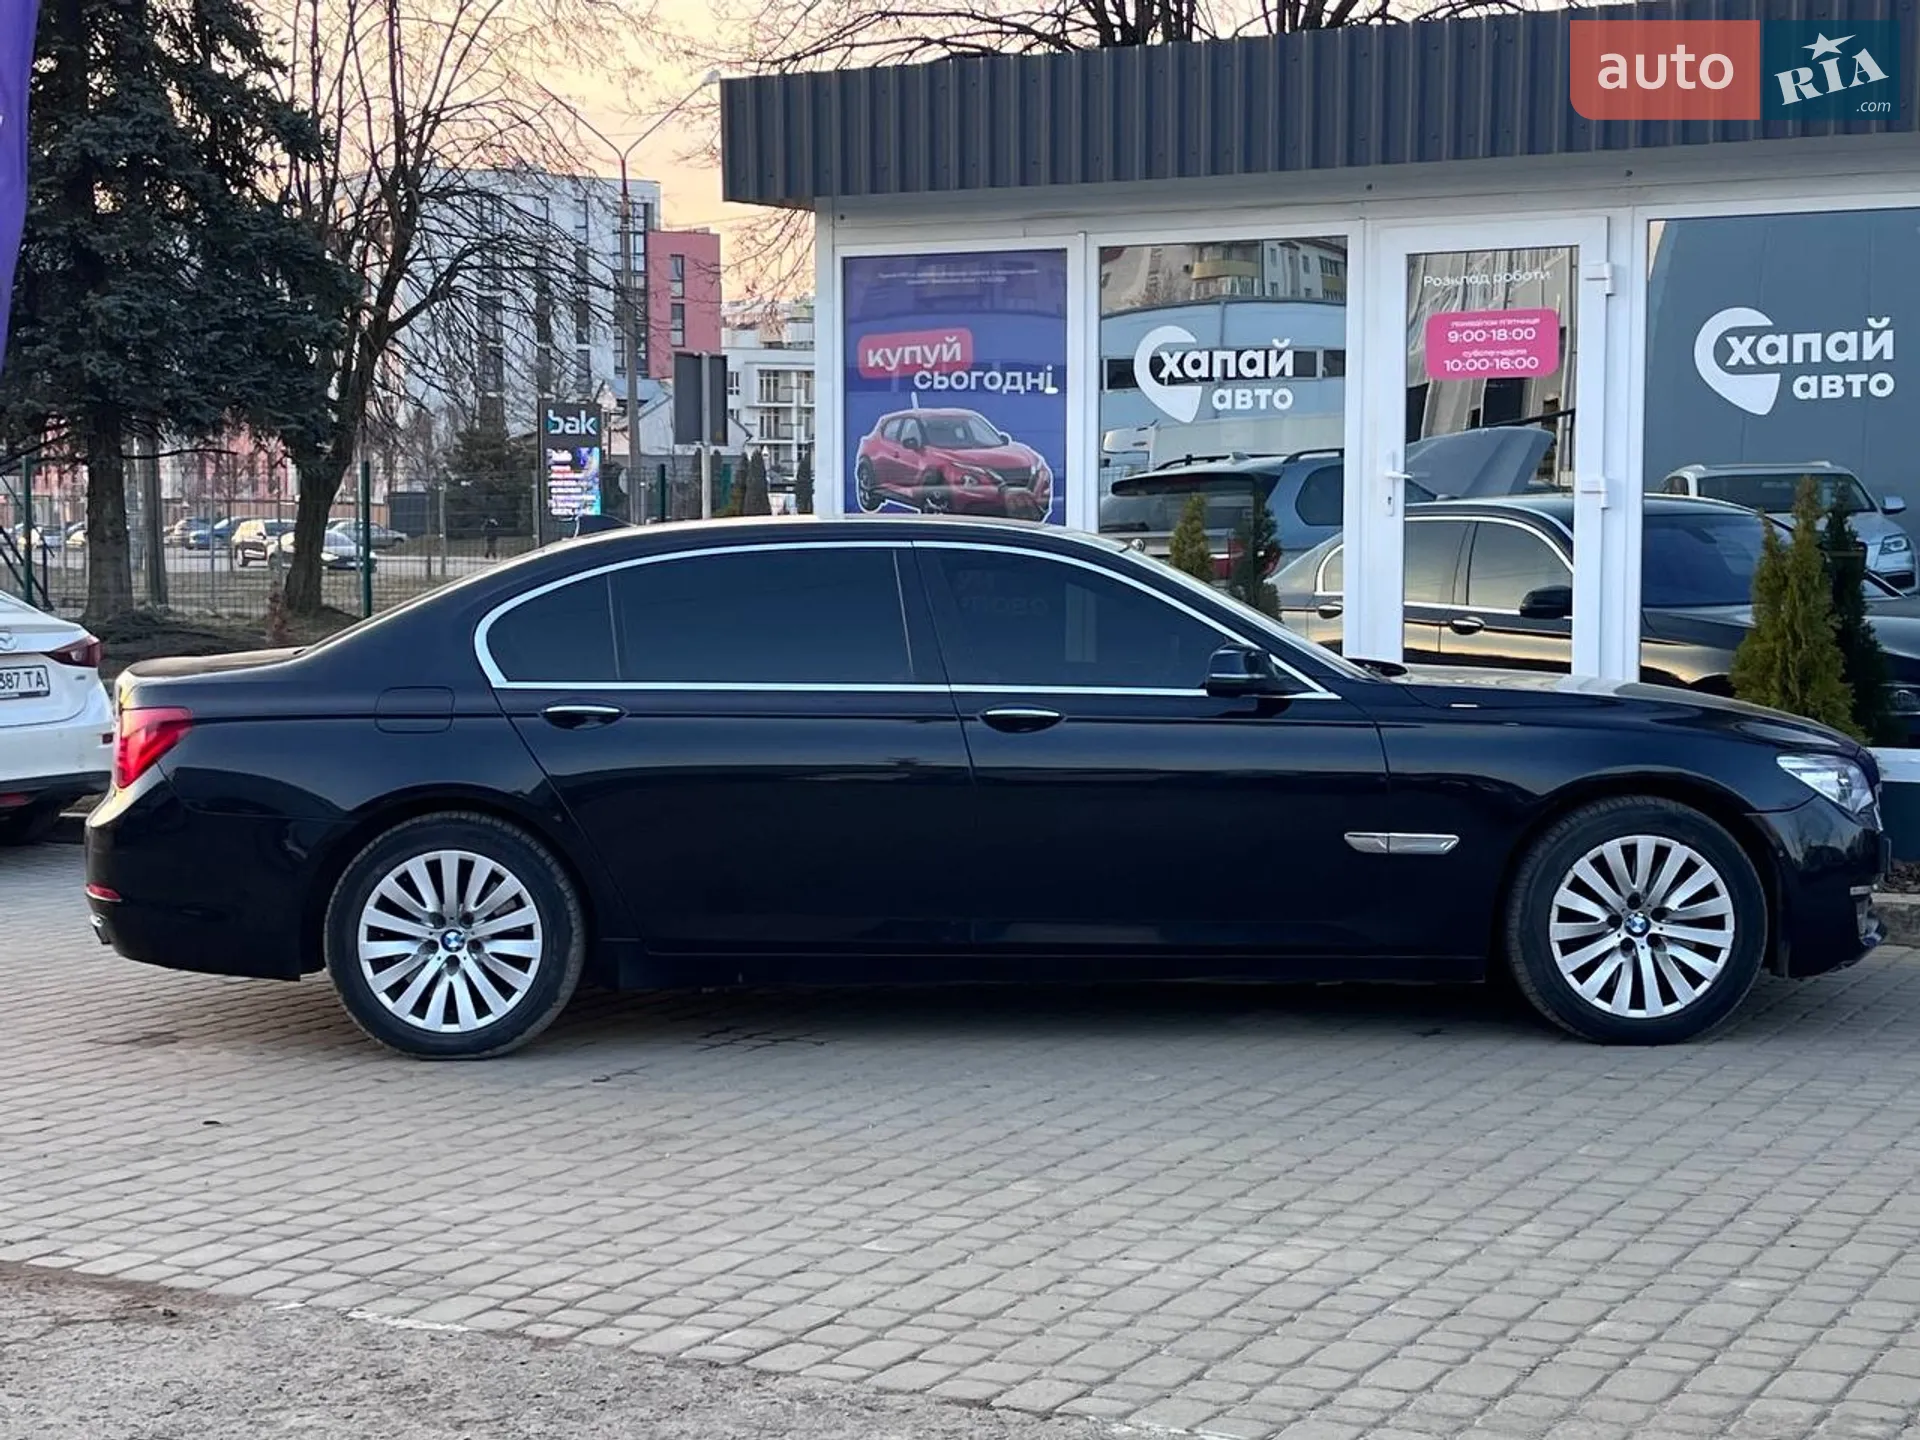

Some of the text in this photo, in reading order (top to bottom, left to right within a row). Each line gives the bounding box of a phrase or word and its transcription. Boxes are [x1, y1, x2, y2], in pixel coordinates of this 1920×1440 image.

[1423, 274, 1491, 288] Розклад
[867, 336, 962, 372] купуй
[1725, 316, 1895, 366] хапай
[1158, 338, 1294, 378] хапай
[913, 365, 1054, 394] сьогодні
[1792, 372, 1895, 400] авто
[1211, 387, 1294, 410] авто
[547, 409, 597, 435] bak
[24, 671, 46, 688] TA
